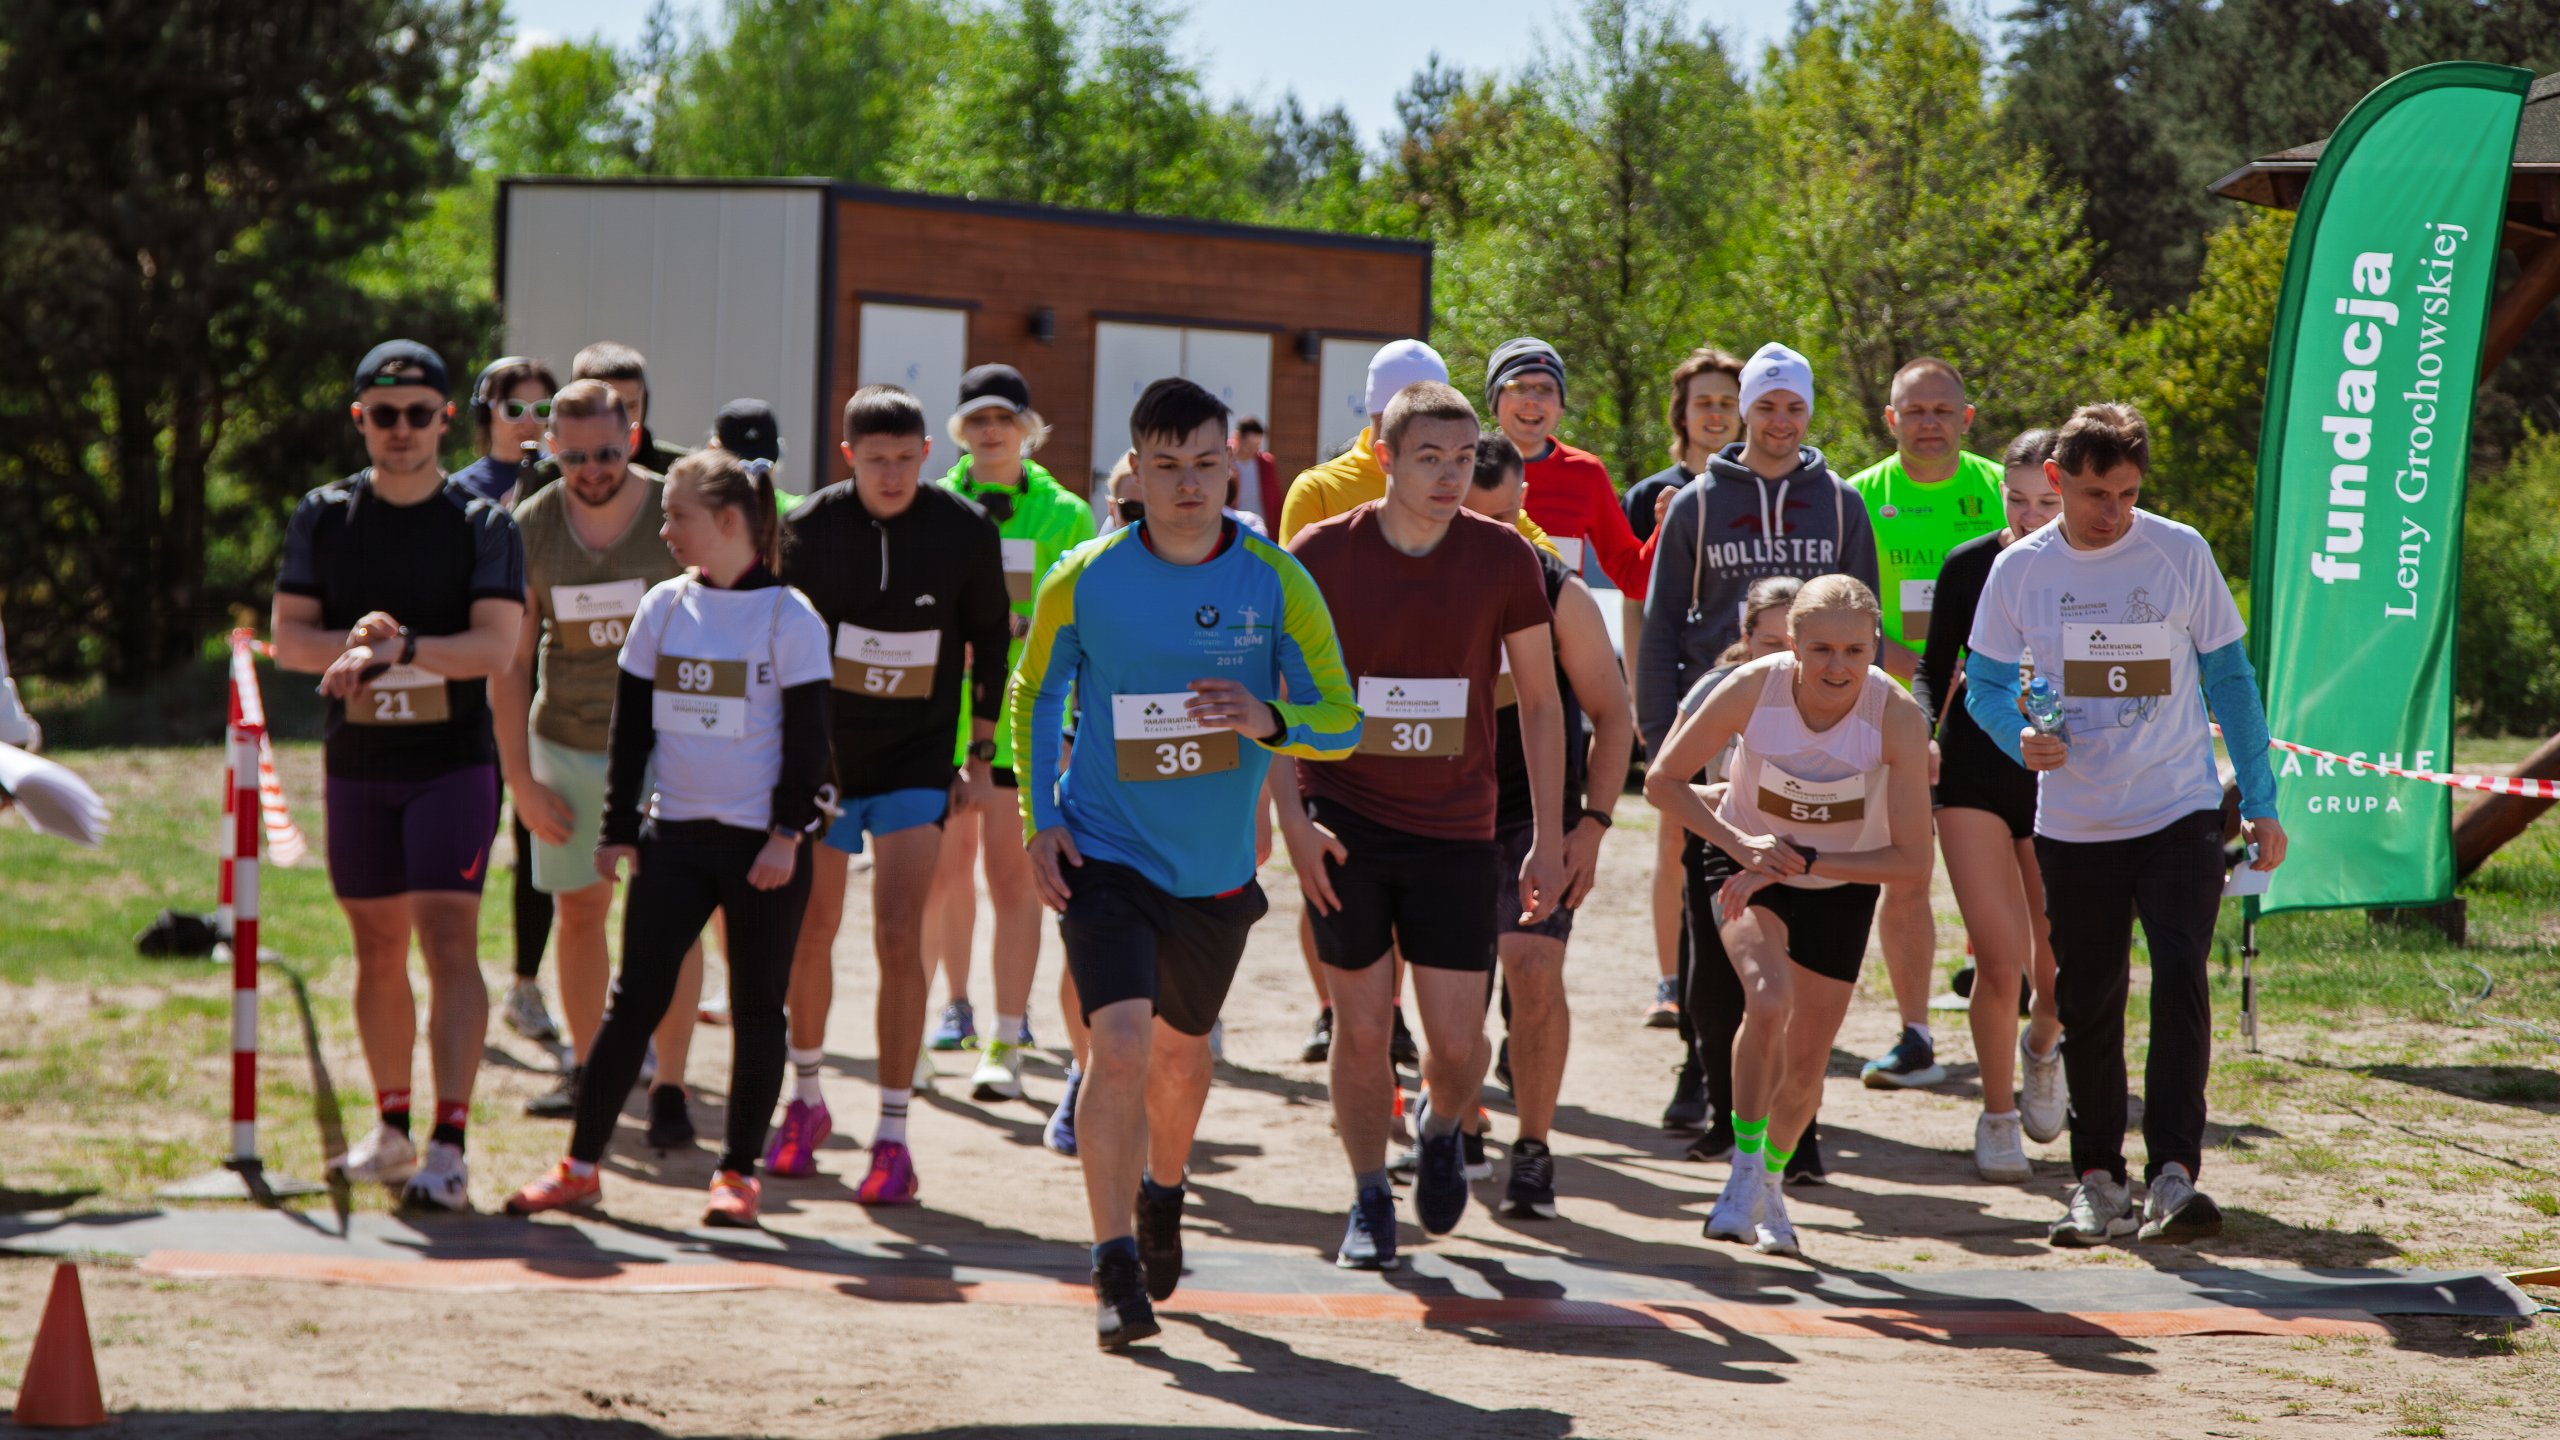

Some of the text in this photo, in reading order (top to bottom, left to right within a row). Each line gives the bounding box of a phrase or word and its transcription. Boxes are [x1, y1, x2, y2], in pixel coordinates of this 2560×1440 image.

[2311, 251, 2399, 584] fundacja
[2385, 222, 2468, 620] Leny Grochowskiej
[1707, 539, 1834, 568] HOLLISTER
[1721, 566, 1824, 579] CALIFORNIA
[588, 620, 625, 647] 60
[678, 661, 714, 692] 99
[864, 667, 905, 694] 57
[2107, 665, 2128, 693] 6
[374, 691, 417, 720] 21
[1391, 722, 1432, 751] 30
[1155, 741, 1202, 774] 36
[2280, 750, 2434, 777] ARCHE
[1791, 803, 1831, 821] 54
[2308, 796, 2402, 813] GRUPA
